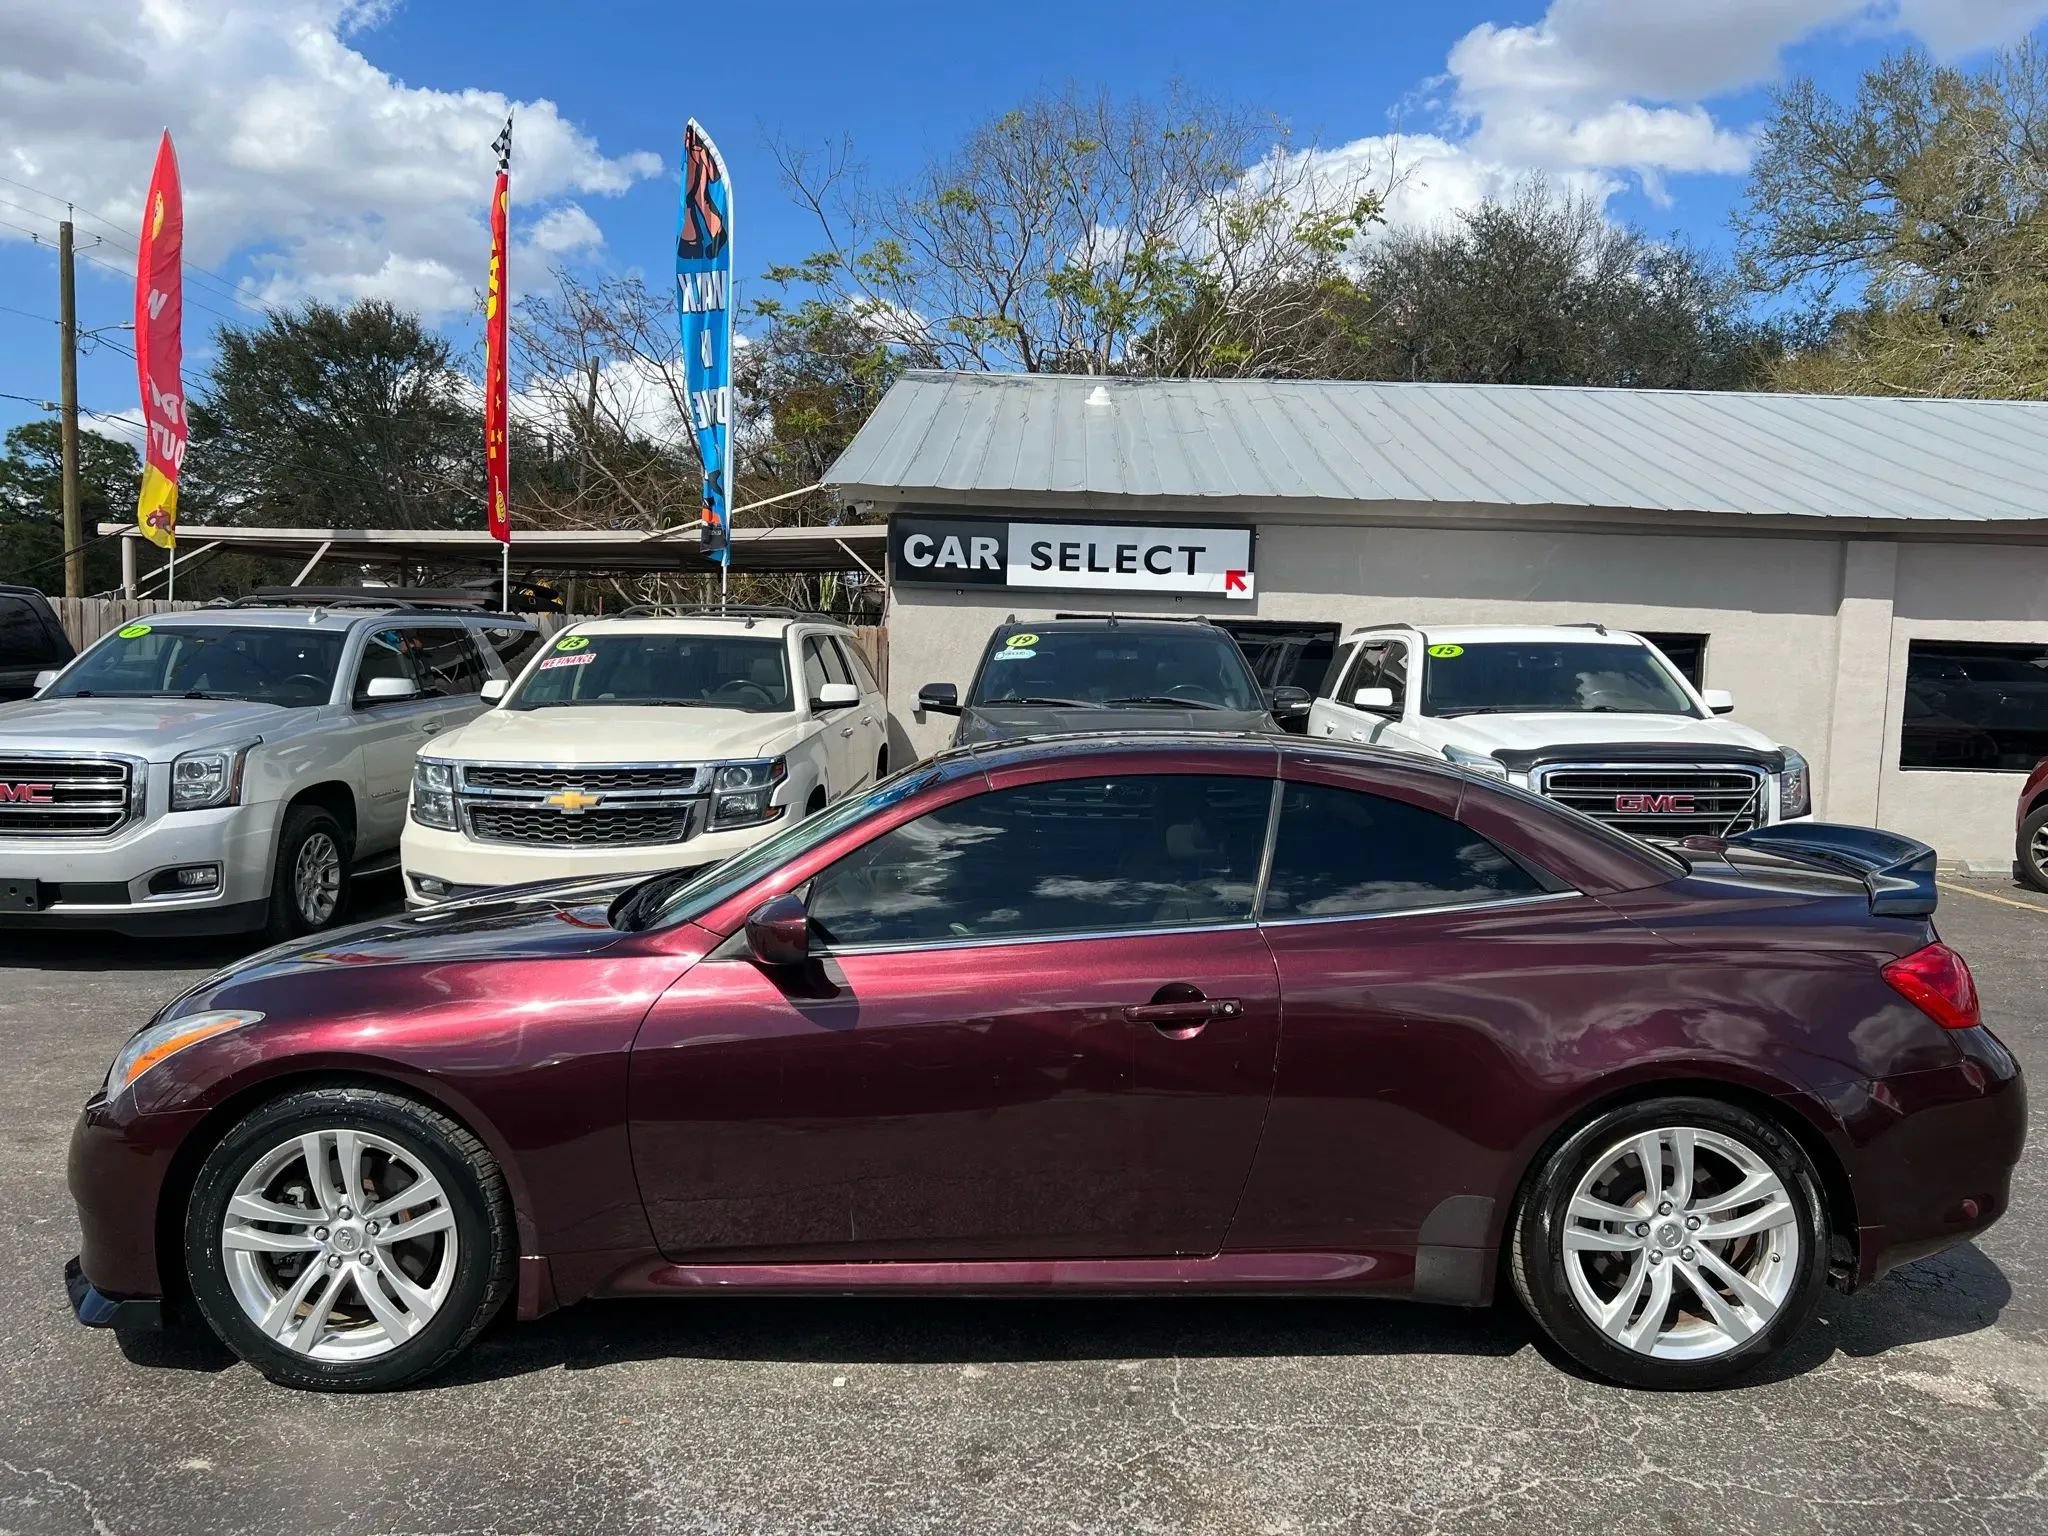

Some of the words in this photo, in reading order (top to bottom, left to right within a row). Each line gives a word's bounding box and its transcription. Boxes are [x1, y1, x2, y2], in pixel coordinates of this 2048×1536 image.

[903, 533, 1001, 570] CAR
[1030, 541, 1207, 576] SELECT
[1012, 635, 1034, 645] 19
[1436, 646, 1456, 655] 15
[557, 653, 594, 665] FINANCE
[0, 783, 53, 802] MC
[1616, 795, 1695, 812] GMC
